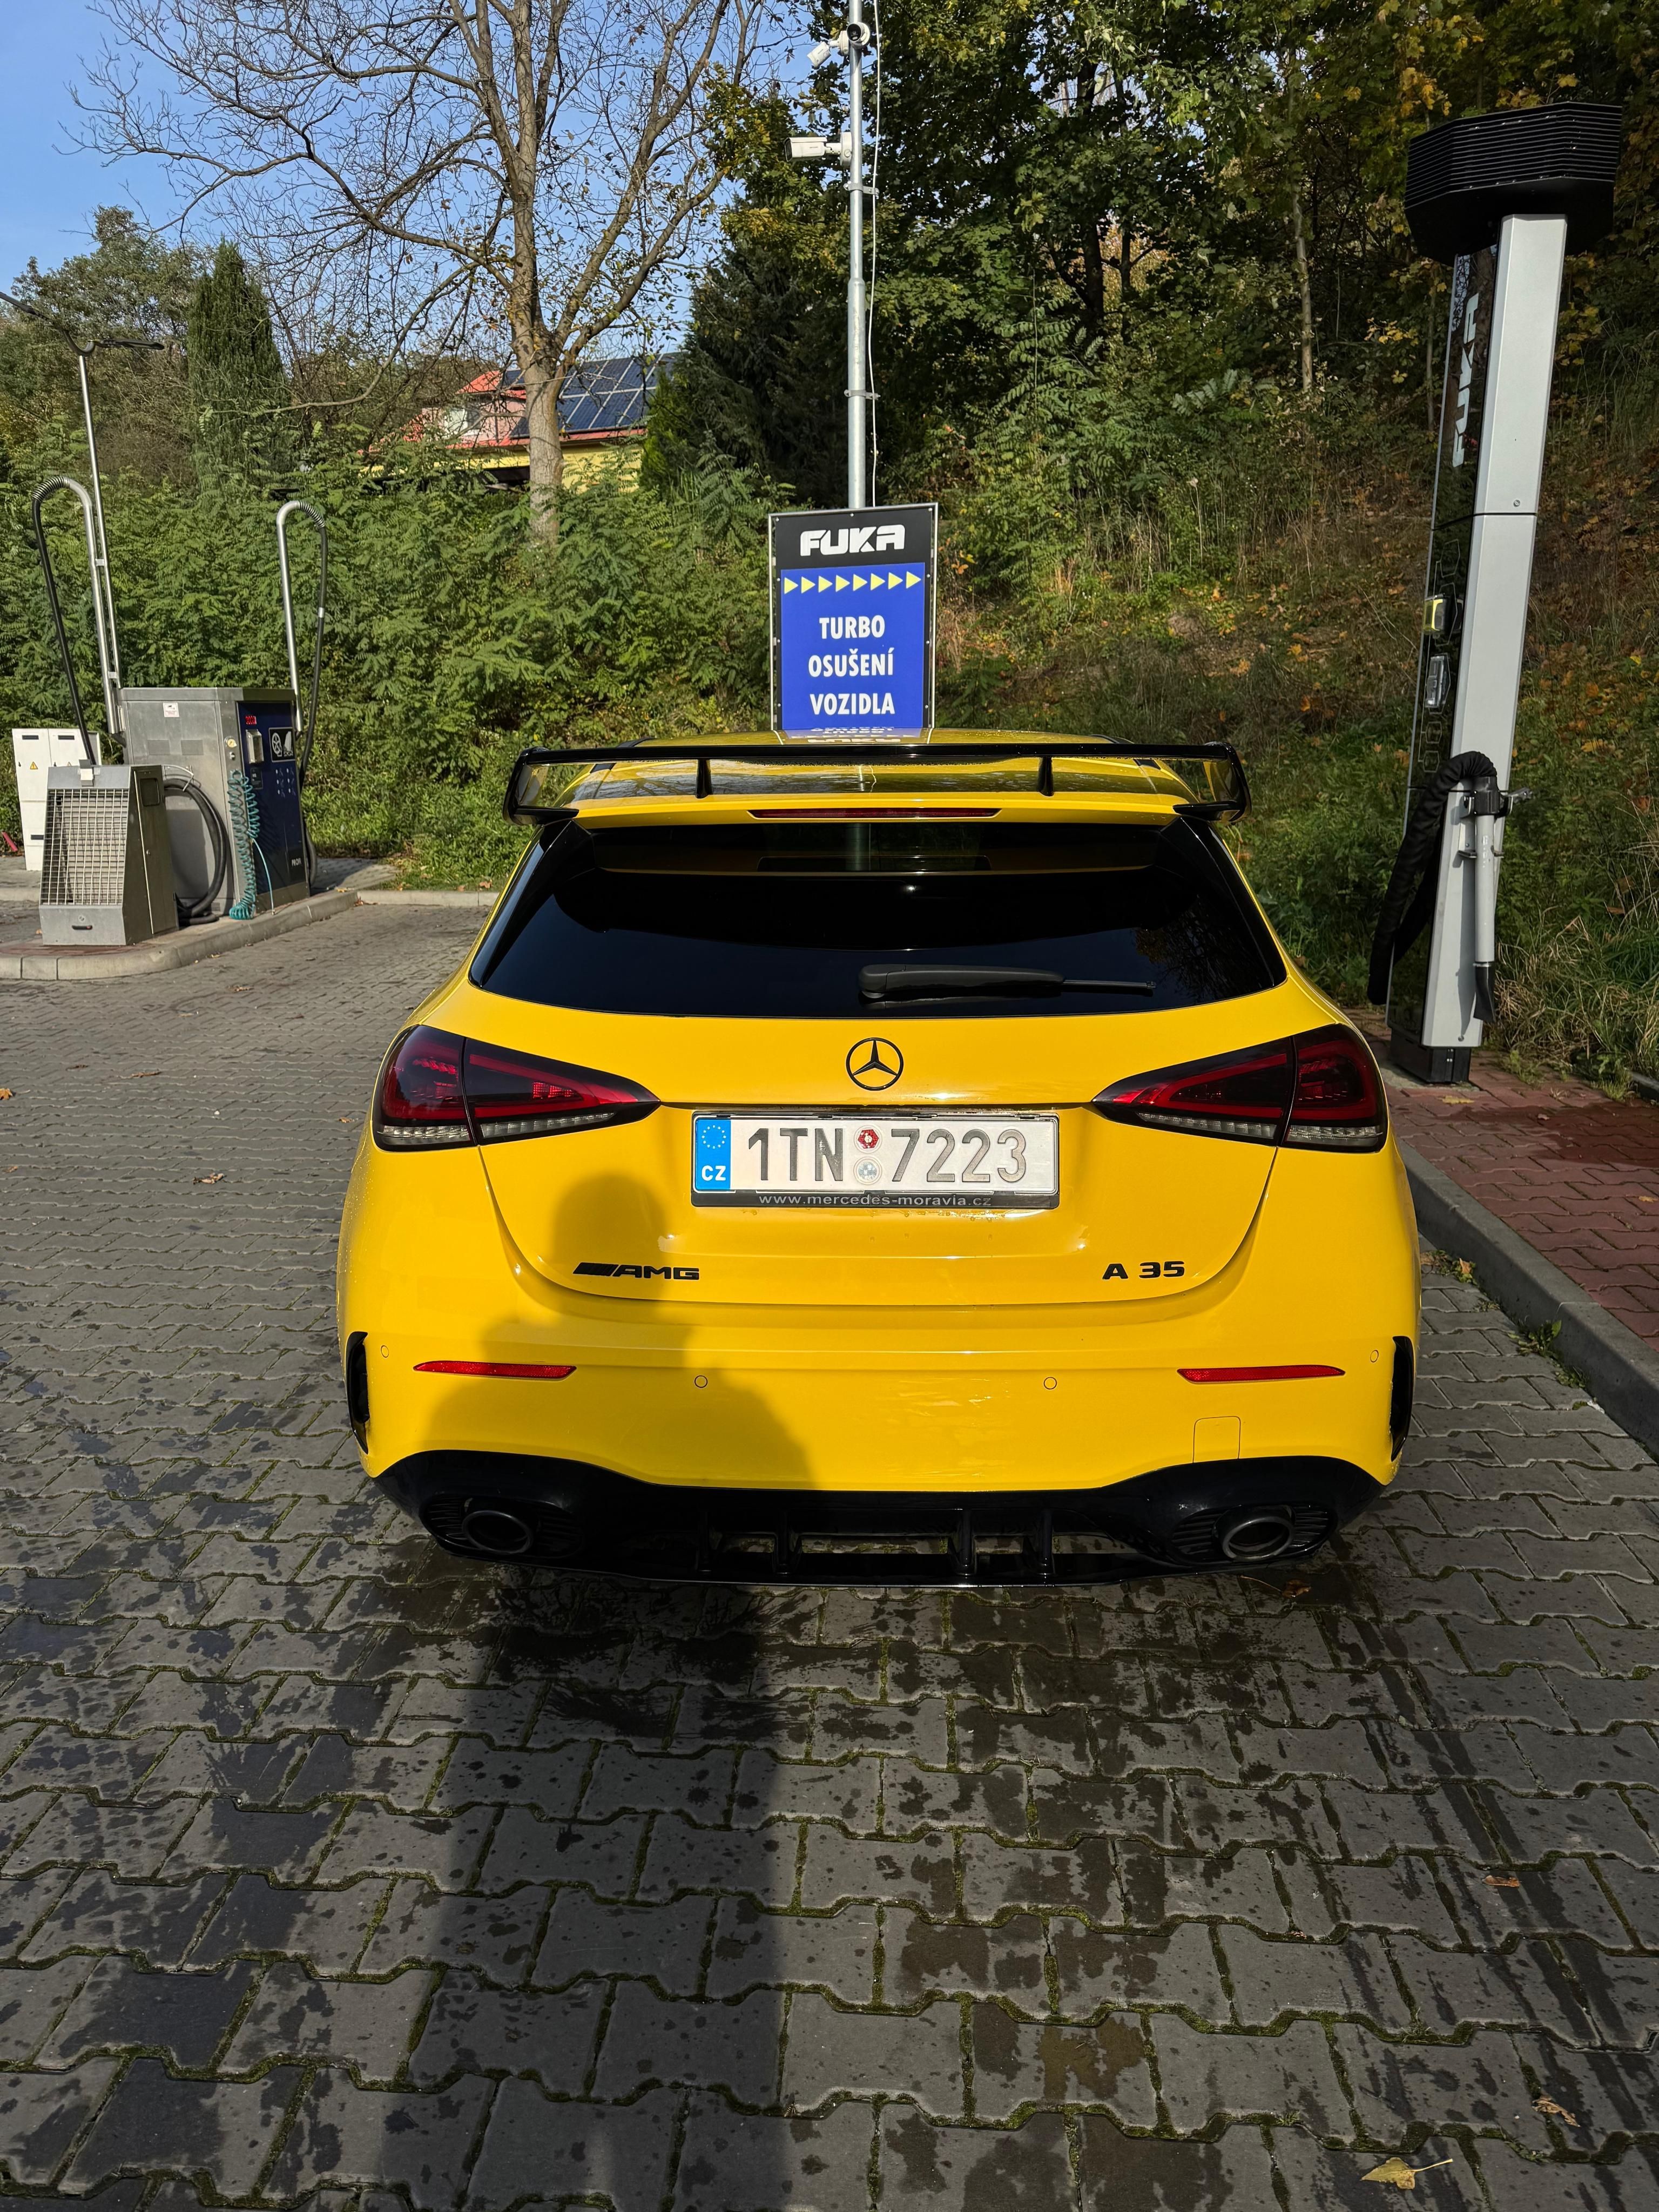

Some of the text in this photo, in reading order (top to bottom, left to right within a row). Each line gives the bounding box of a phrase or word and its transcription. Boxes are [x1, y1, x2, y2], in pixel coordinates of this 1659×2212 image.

[1452, 292, 1479, 468] FUKA
[800, 524, 906, 556] FUKA
[819, 615, 885, 639] TURBO
[808, 648, 894, 677] OSUŠENÍ
[810, 692, 895, 715] VOZIDLA
[748, 1127, 1027, 1183] 1TN 7223
[701, 1164, 726, 1182] CZ
[758, 1194, 992, 1206] www.mercedes-moravia.cz
[612, 1264, 700, 1280] AMG
[1102, 1260, 1185, 1280] A 35
